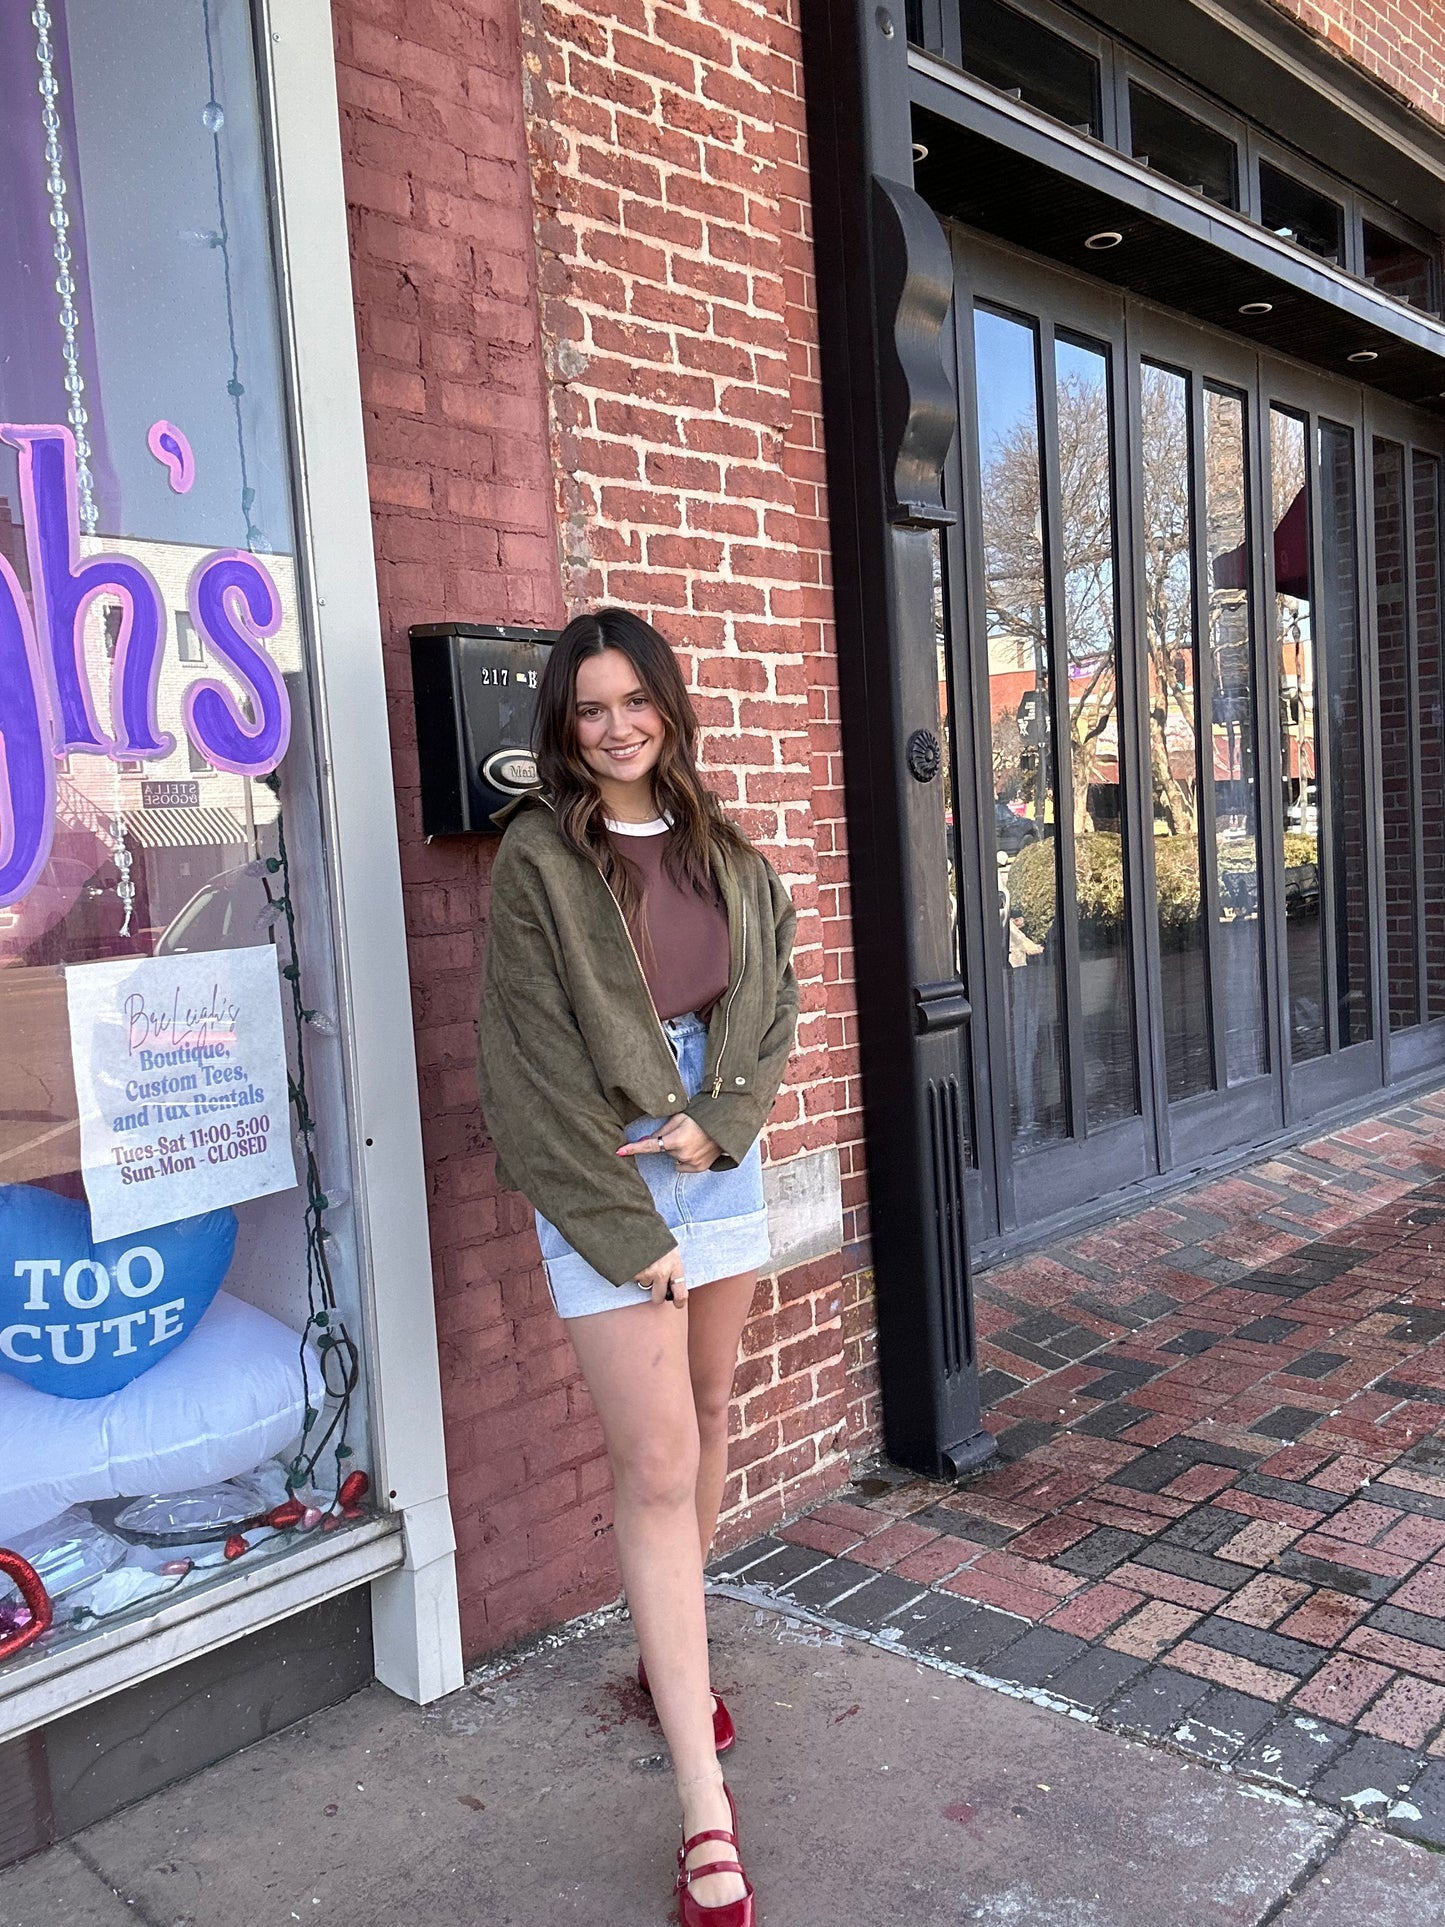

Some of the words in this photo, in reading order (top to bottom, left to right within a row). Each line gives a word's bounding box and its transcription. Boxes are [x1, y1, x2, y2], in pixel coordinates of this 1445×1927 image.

[481, 667, 509, 687] 217
[139, 1041, 231, 1072] Boutique,
[112, 1104, 150, 1132] and
[152, 1101, 191, 1124] Tux
[193, 1083, 265, 1116] Rentals
[125, 1073, 198, 1102] Custom
[201, 1064, 248, 1087] Tees,
[112, 1134, 187, 1166] Tues-Sat
[190, 1114, 270, 1149] 11:00-5:00
[120, 1155, 196, 1185] Sun-Mon
[207, 1135, 268, 1165] CLOSED
[14, 1246, 165, 1310] TOO
[0, 1298, 186, 1366] CUTE
